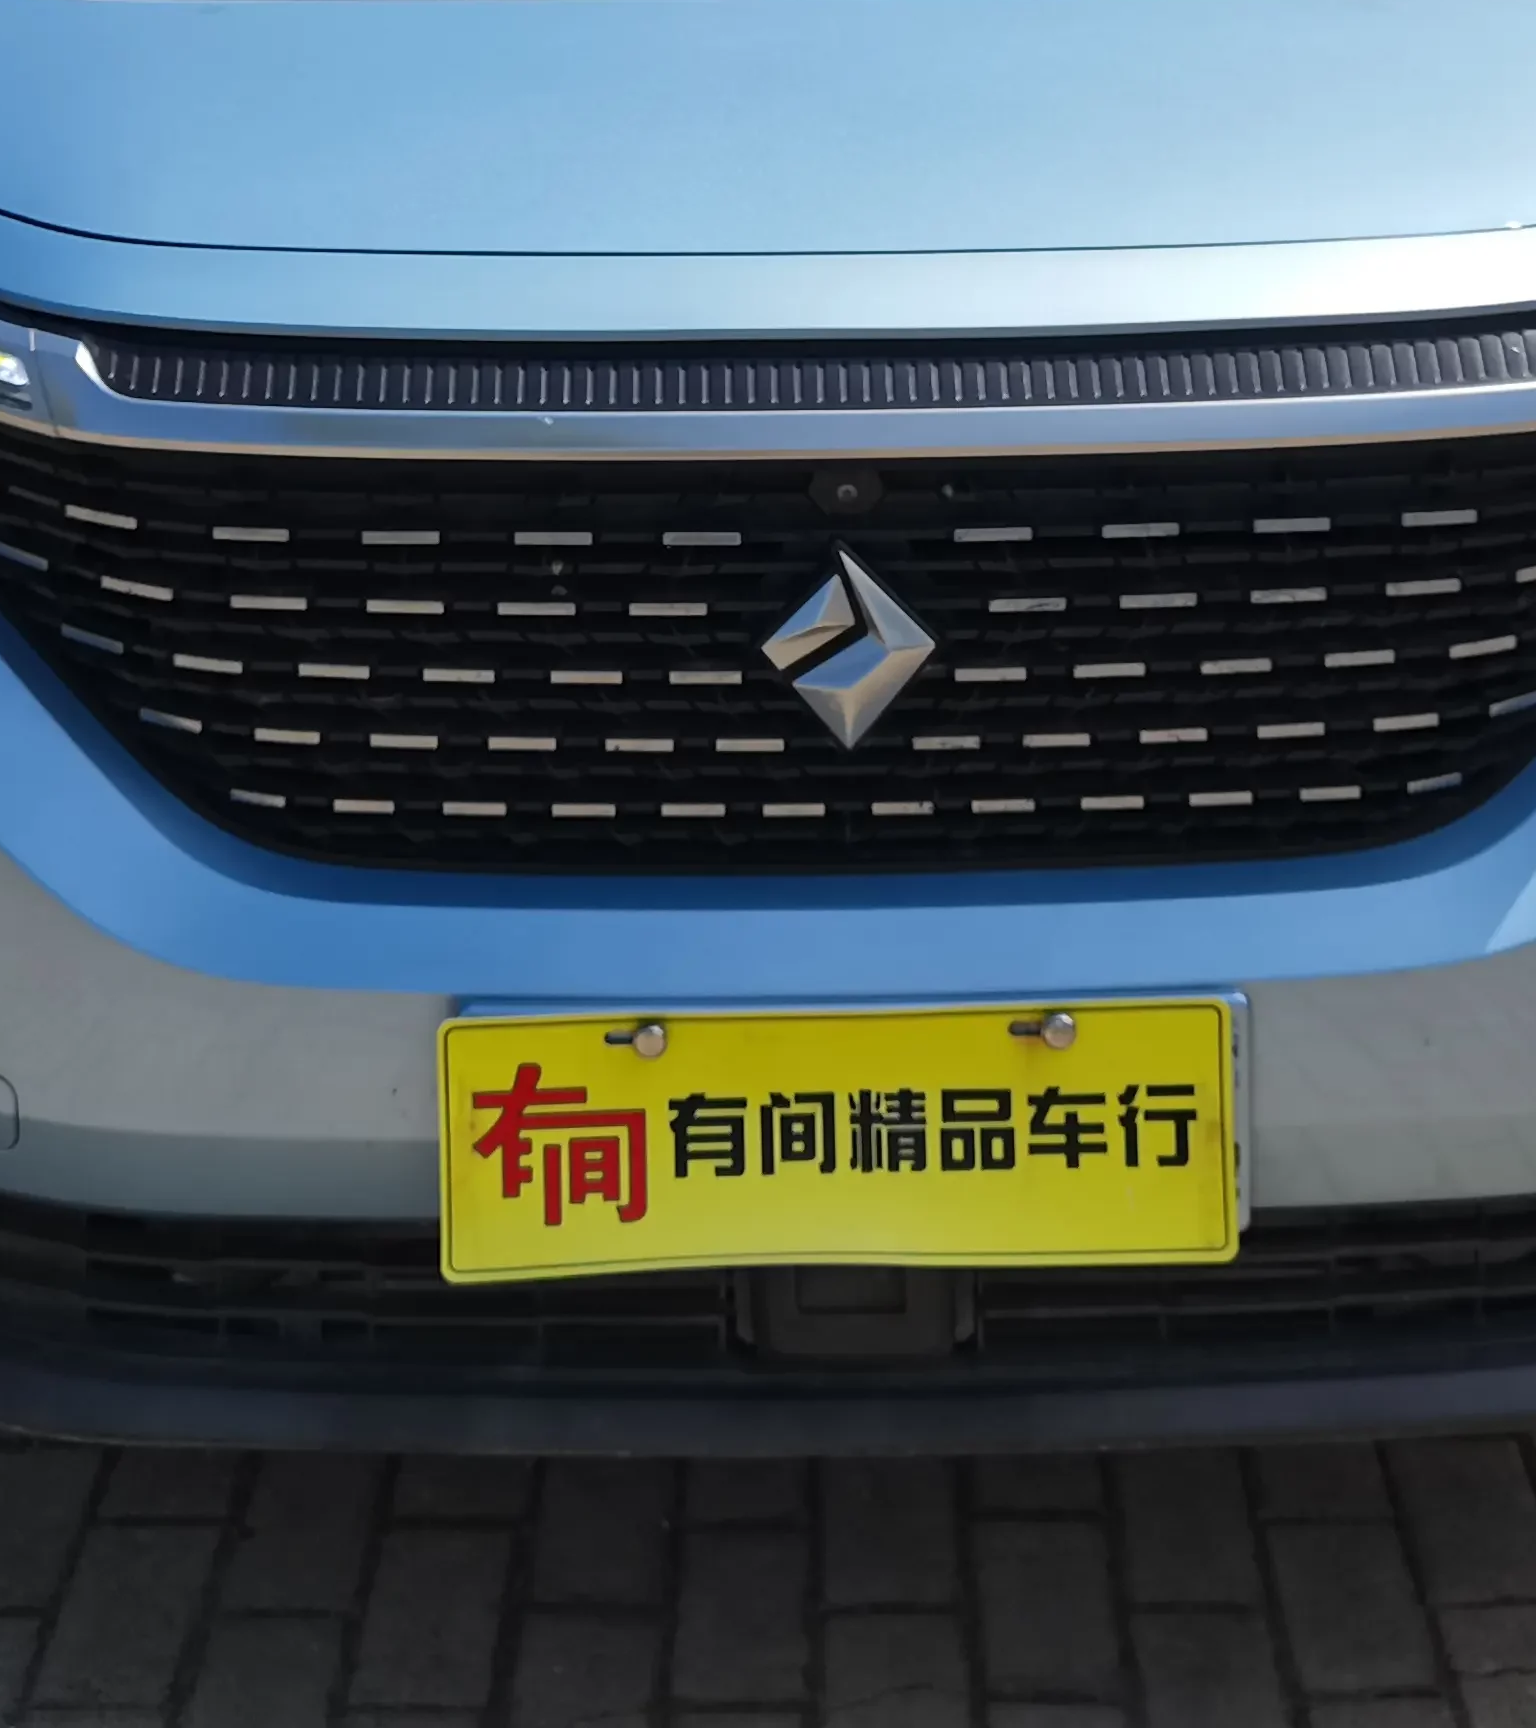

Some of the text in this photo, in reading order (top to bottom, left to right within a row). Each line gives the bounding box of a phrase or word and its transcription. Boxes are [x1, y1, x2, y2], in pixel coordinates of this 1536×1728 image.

[667, 1083, 1199, 1179] 有间精品车行
